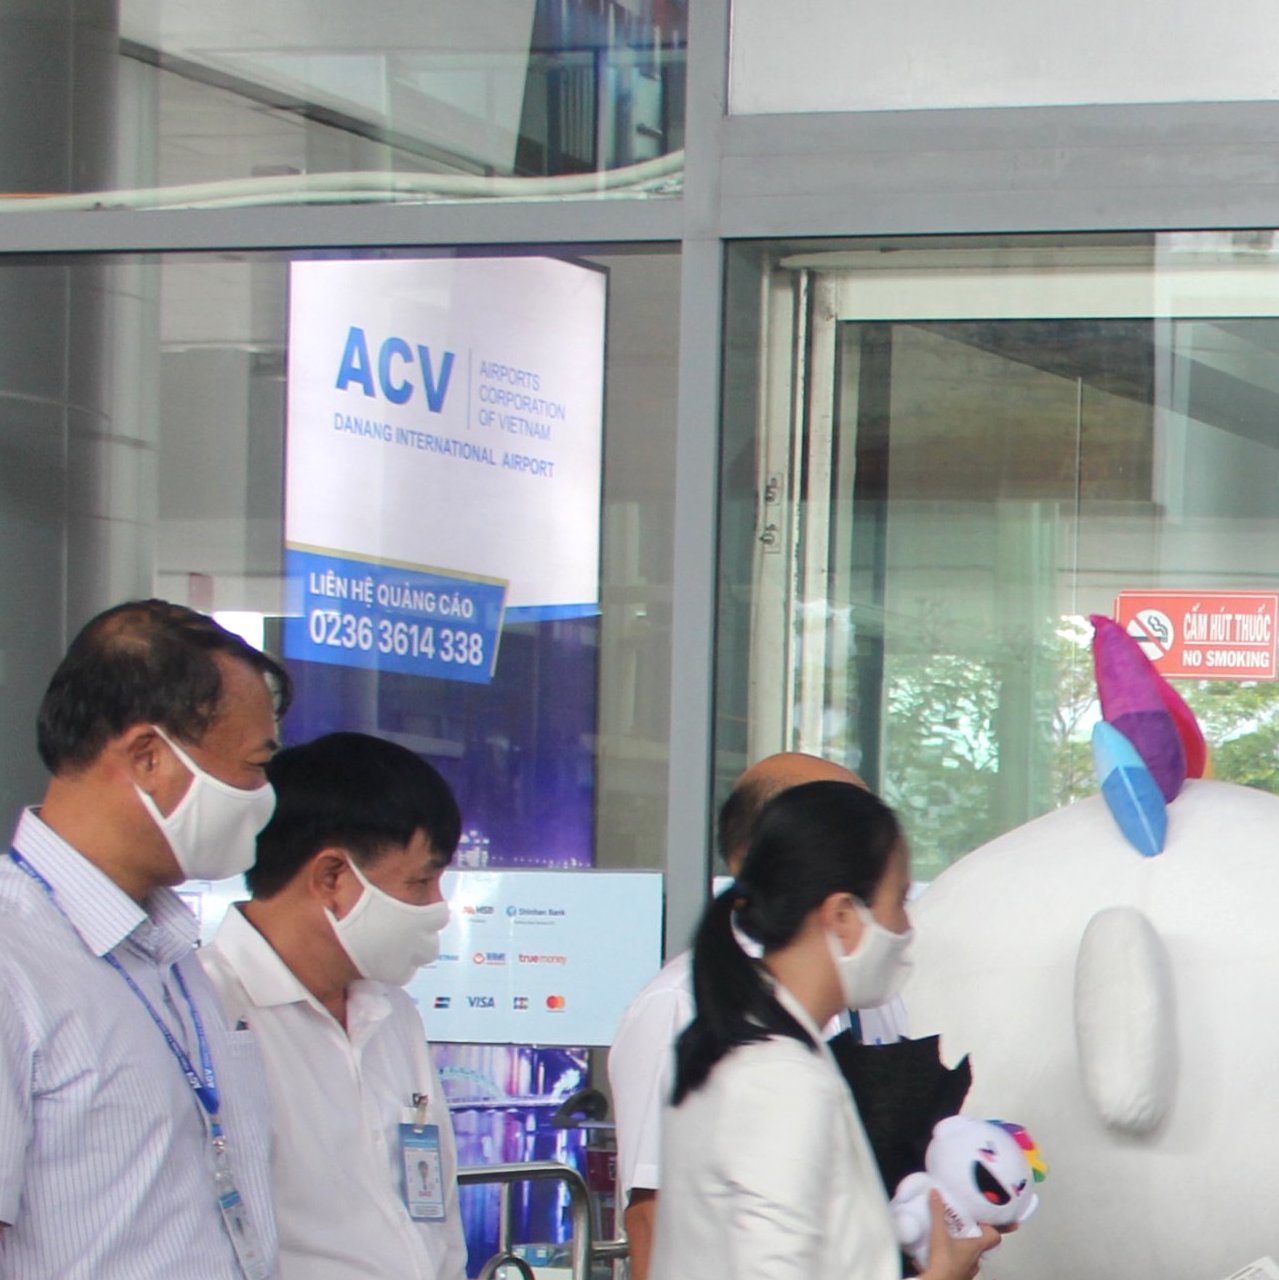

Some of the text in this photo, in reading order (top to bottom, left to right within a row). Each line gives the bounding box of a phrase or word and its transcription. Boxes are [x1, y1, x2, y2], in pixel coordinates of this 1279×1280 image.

[335, 325, 456, 415] ACV
[479, 360, 541, 392] AIRPORTS
[479, 384, 566, 422] CORPORATION
[479, 409, 551, 441] OF VIETNAM
[334, 412, 555, 478] DANANG INTERNATIONAL AIRPORT
[310, 570, 348, 599] LIÊN
[351, 576, 374, 608] HỆ
[438, 591, 474, 619] CÁO
[310, 609, 483, 666] 0236 3614 338
[1183, 603, 1271, 642] CẤM HÚT THUỐC
[1183, 650, 1270, 668] NO SMOKING
[467, 995, 495, 1008] VISA
